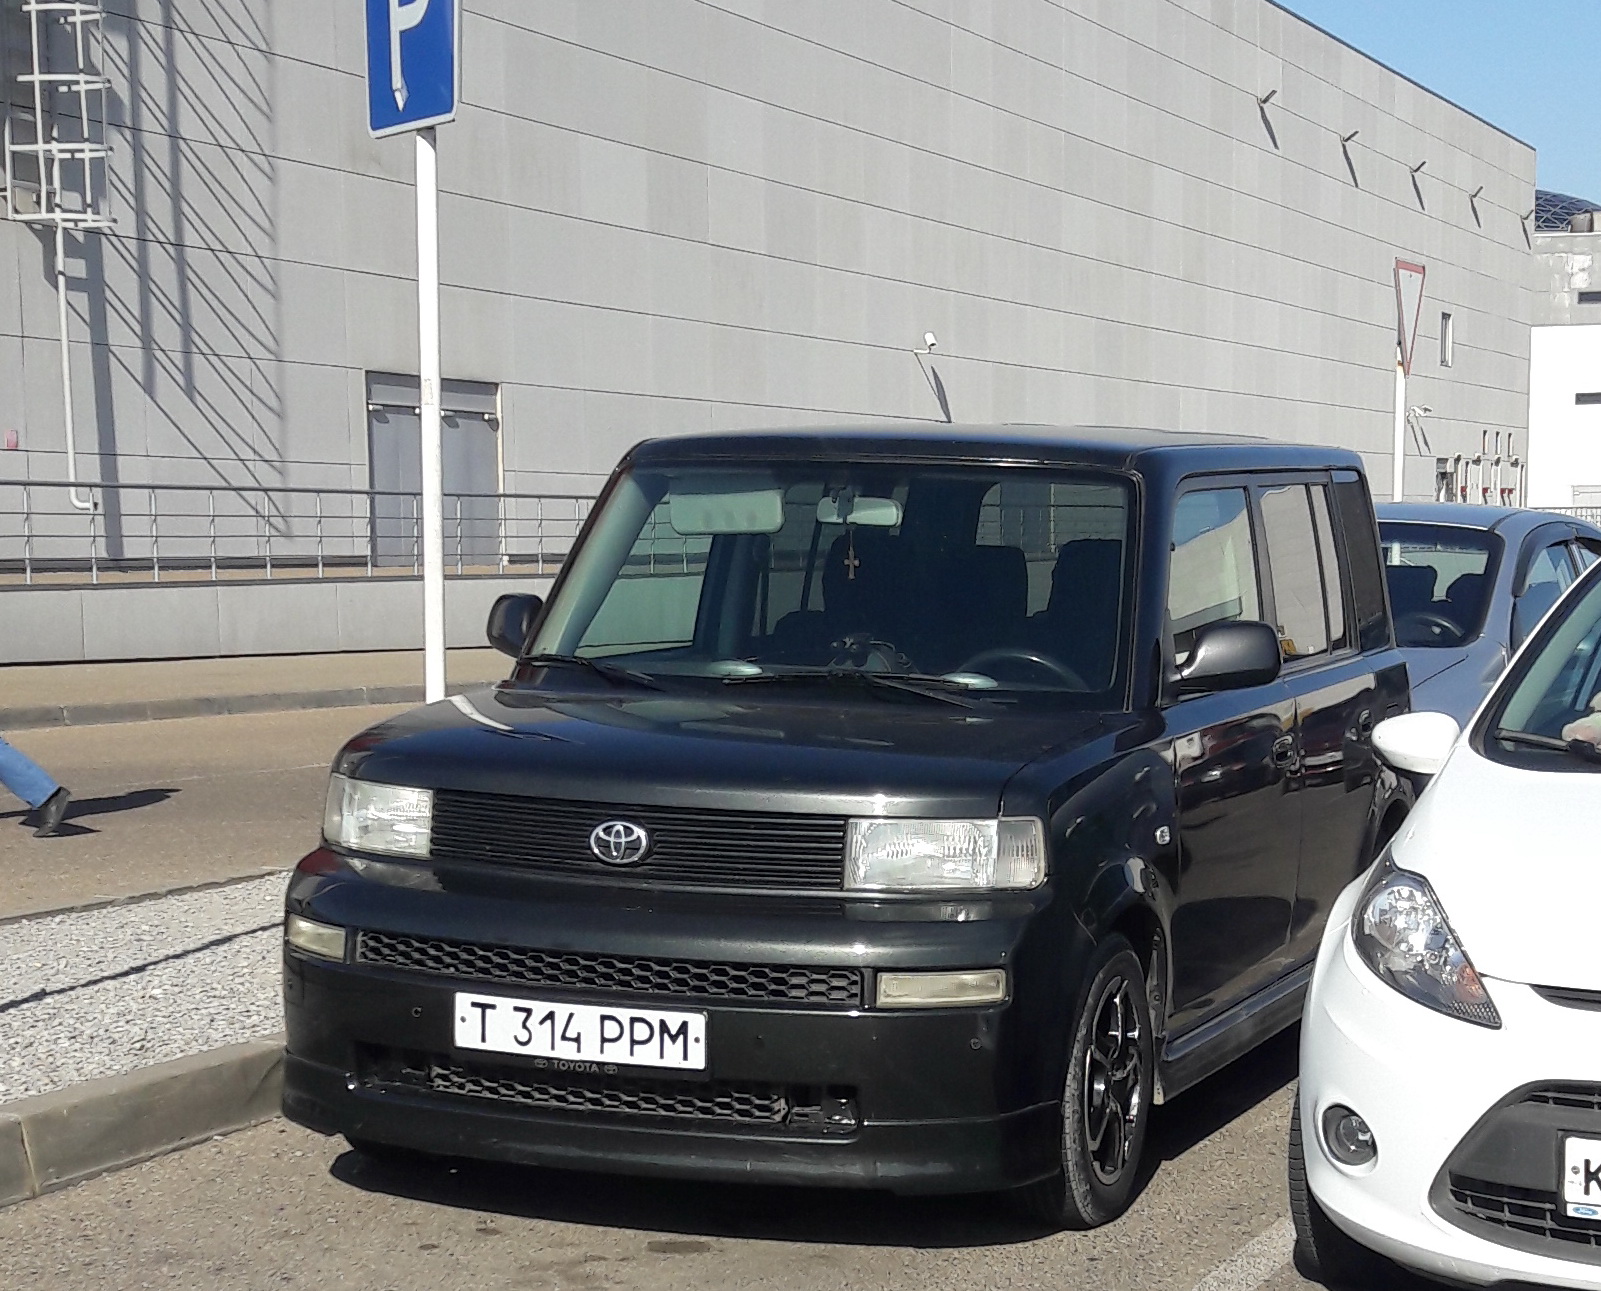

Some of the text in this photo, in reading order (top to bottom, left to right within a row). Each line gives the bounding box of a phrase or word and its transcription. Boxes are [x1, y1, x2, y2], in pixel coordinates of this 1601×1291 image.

[470, 1001, 689, 1062] T 314 PPM
[552, 1060, 600, 1073] TOYOTA
